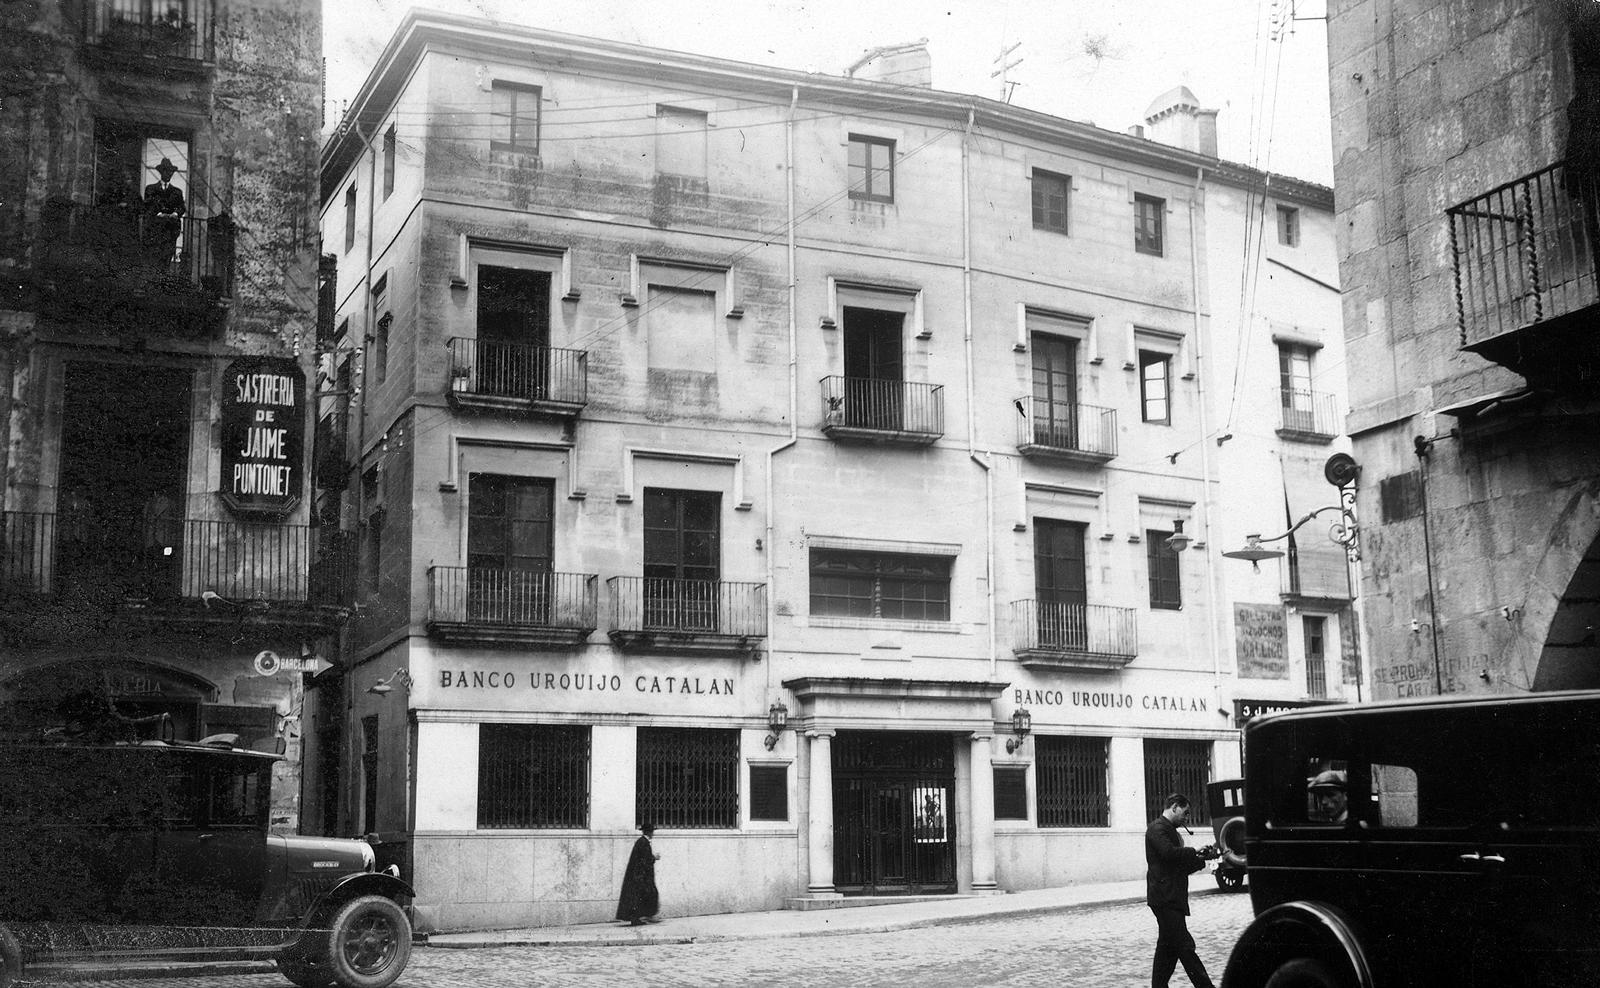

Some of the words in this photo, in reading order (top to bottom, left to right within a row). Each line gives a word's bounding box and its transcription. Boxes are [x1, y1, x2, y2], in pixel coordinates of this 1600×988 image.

[236, 374, 295, 407] SASTRERIA
[255, 409, 275, 422] DE
[240, 427, 288, 460] JAIME
[233, 463, 292, 496] PUNTONET
[280, 658, 319, 671] BARCELONA
[440, 670, 516, 689] BANCO
[530, 673, 622, 691] URQUIJO
[635, 676, 735, 696] CATALAN
[1014, 689, 1063, 706] BANCO
[1072, 691, 1133, 709] URQUIJO
[1142, 695, 1207, 712] CATALAN
